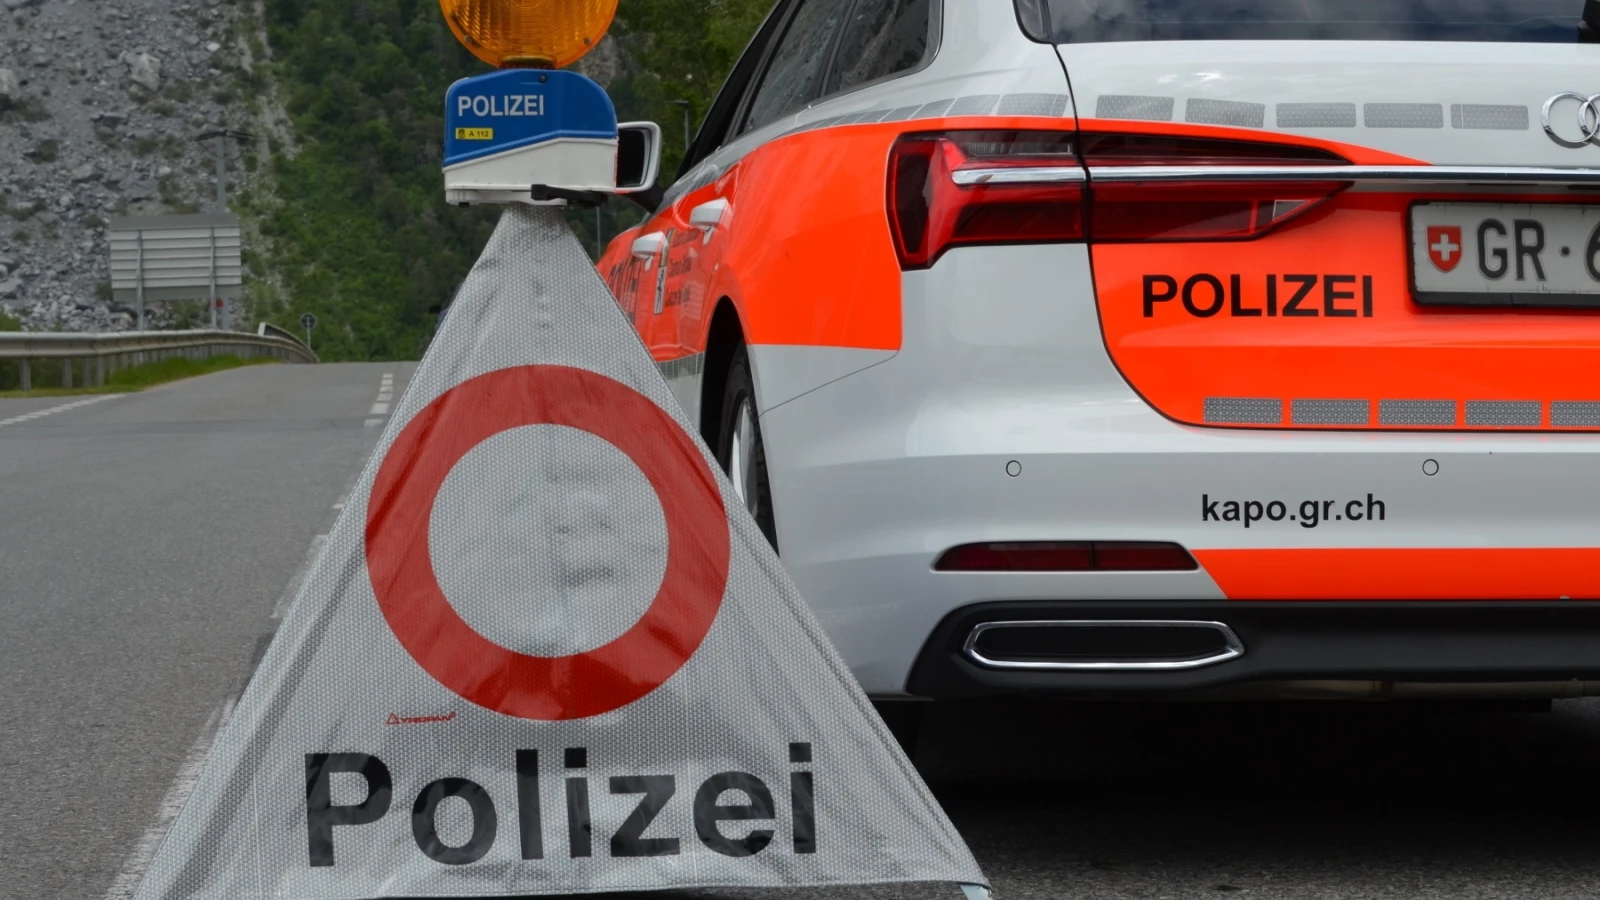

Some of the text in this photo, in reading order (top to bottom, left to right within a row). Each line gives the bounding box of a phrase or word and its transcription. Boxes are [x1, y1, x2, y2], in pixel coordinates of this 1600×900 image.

[458, 95, 544, 117] POLIZEI
[1142, 273, 1373, 318] POLIZEI
[1201, 493, 1386, 528] kapo.gr.ch
[304, 742, 817, 868] Polizei
